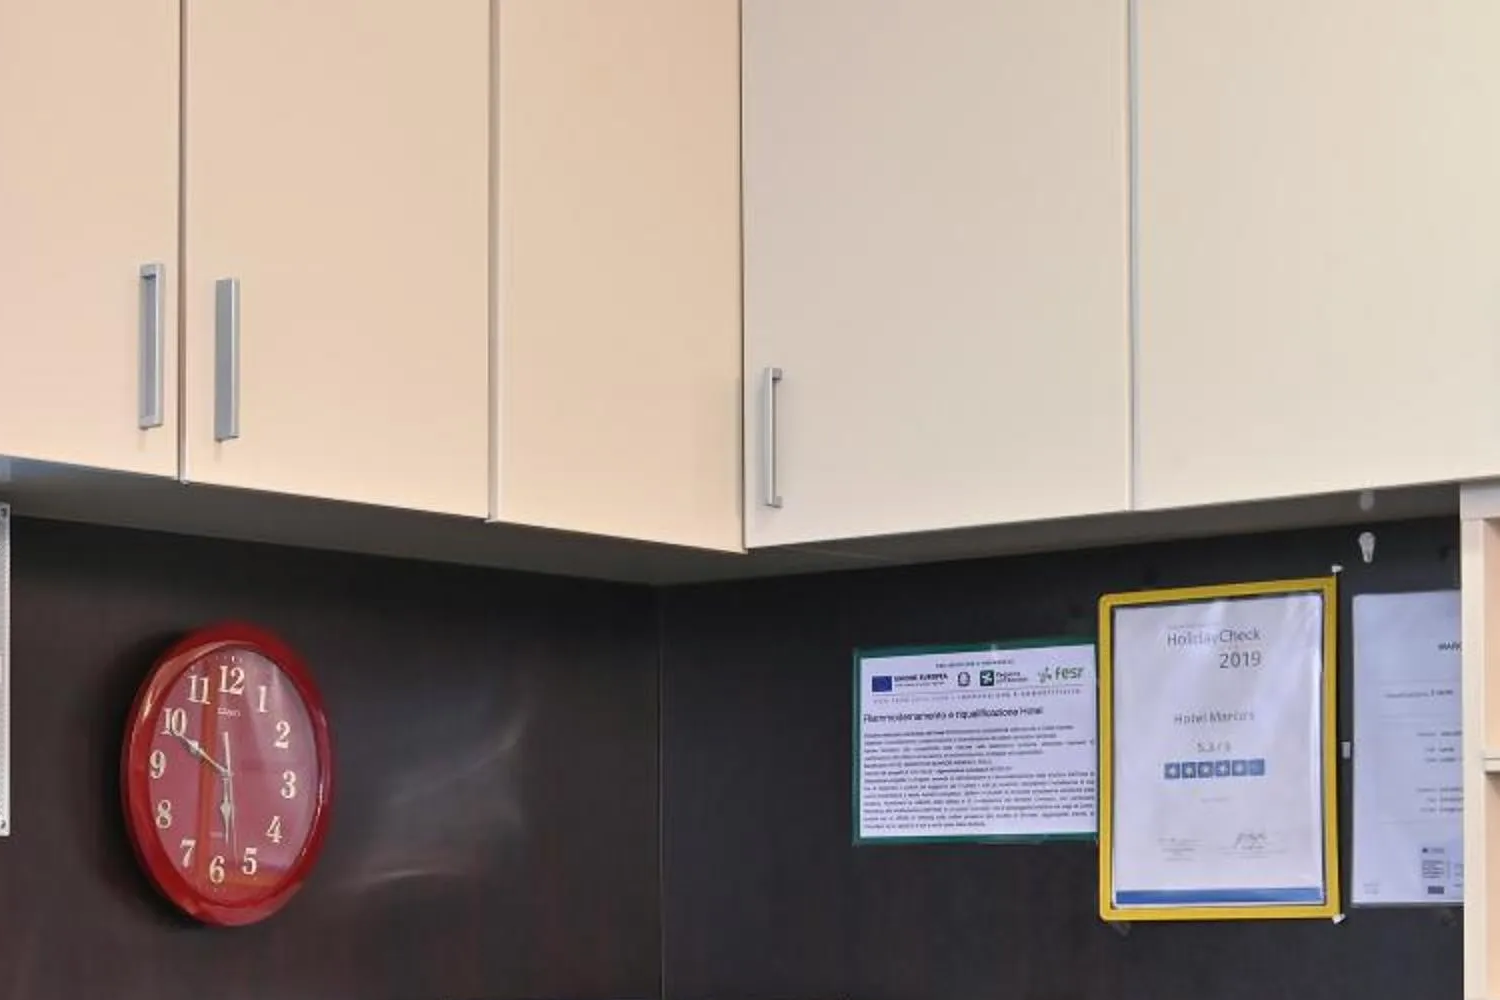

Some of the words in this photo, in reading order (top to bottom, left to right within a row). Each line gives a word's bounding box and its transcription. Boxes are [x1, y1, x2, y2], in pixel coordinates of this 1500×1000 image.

[1167, 627, 1261, 646] HolidayCheck
[1055, 665, 1085, 680] fesr
[1219, 651, 1262, 669] 2019
[188, 675, 211, 705] 11
[218, 665, 246, 695] 12
[258, 685, 269, 713] 1
[160, 707, 188, 736] 10
[1174, 712, 1207, 725] Hotel
[273, 721, 291, 749] 2
[149, 750, 167, 779] 9
[280, 769, 297, 799] 3
[156, 799, 173, 829] 8
[266, 815, 283, 843] 4
[180, 839, 196, 868] 7
[242, 847, 258, 875] 5
[209, 855, 226, 883] 6
